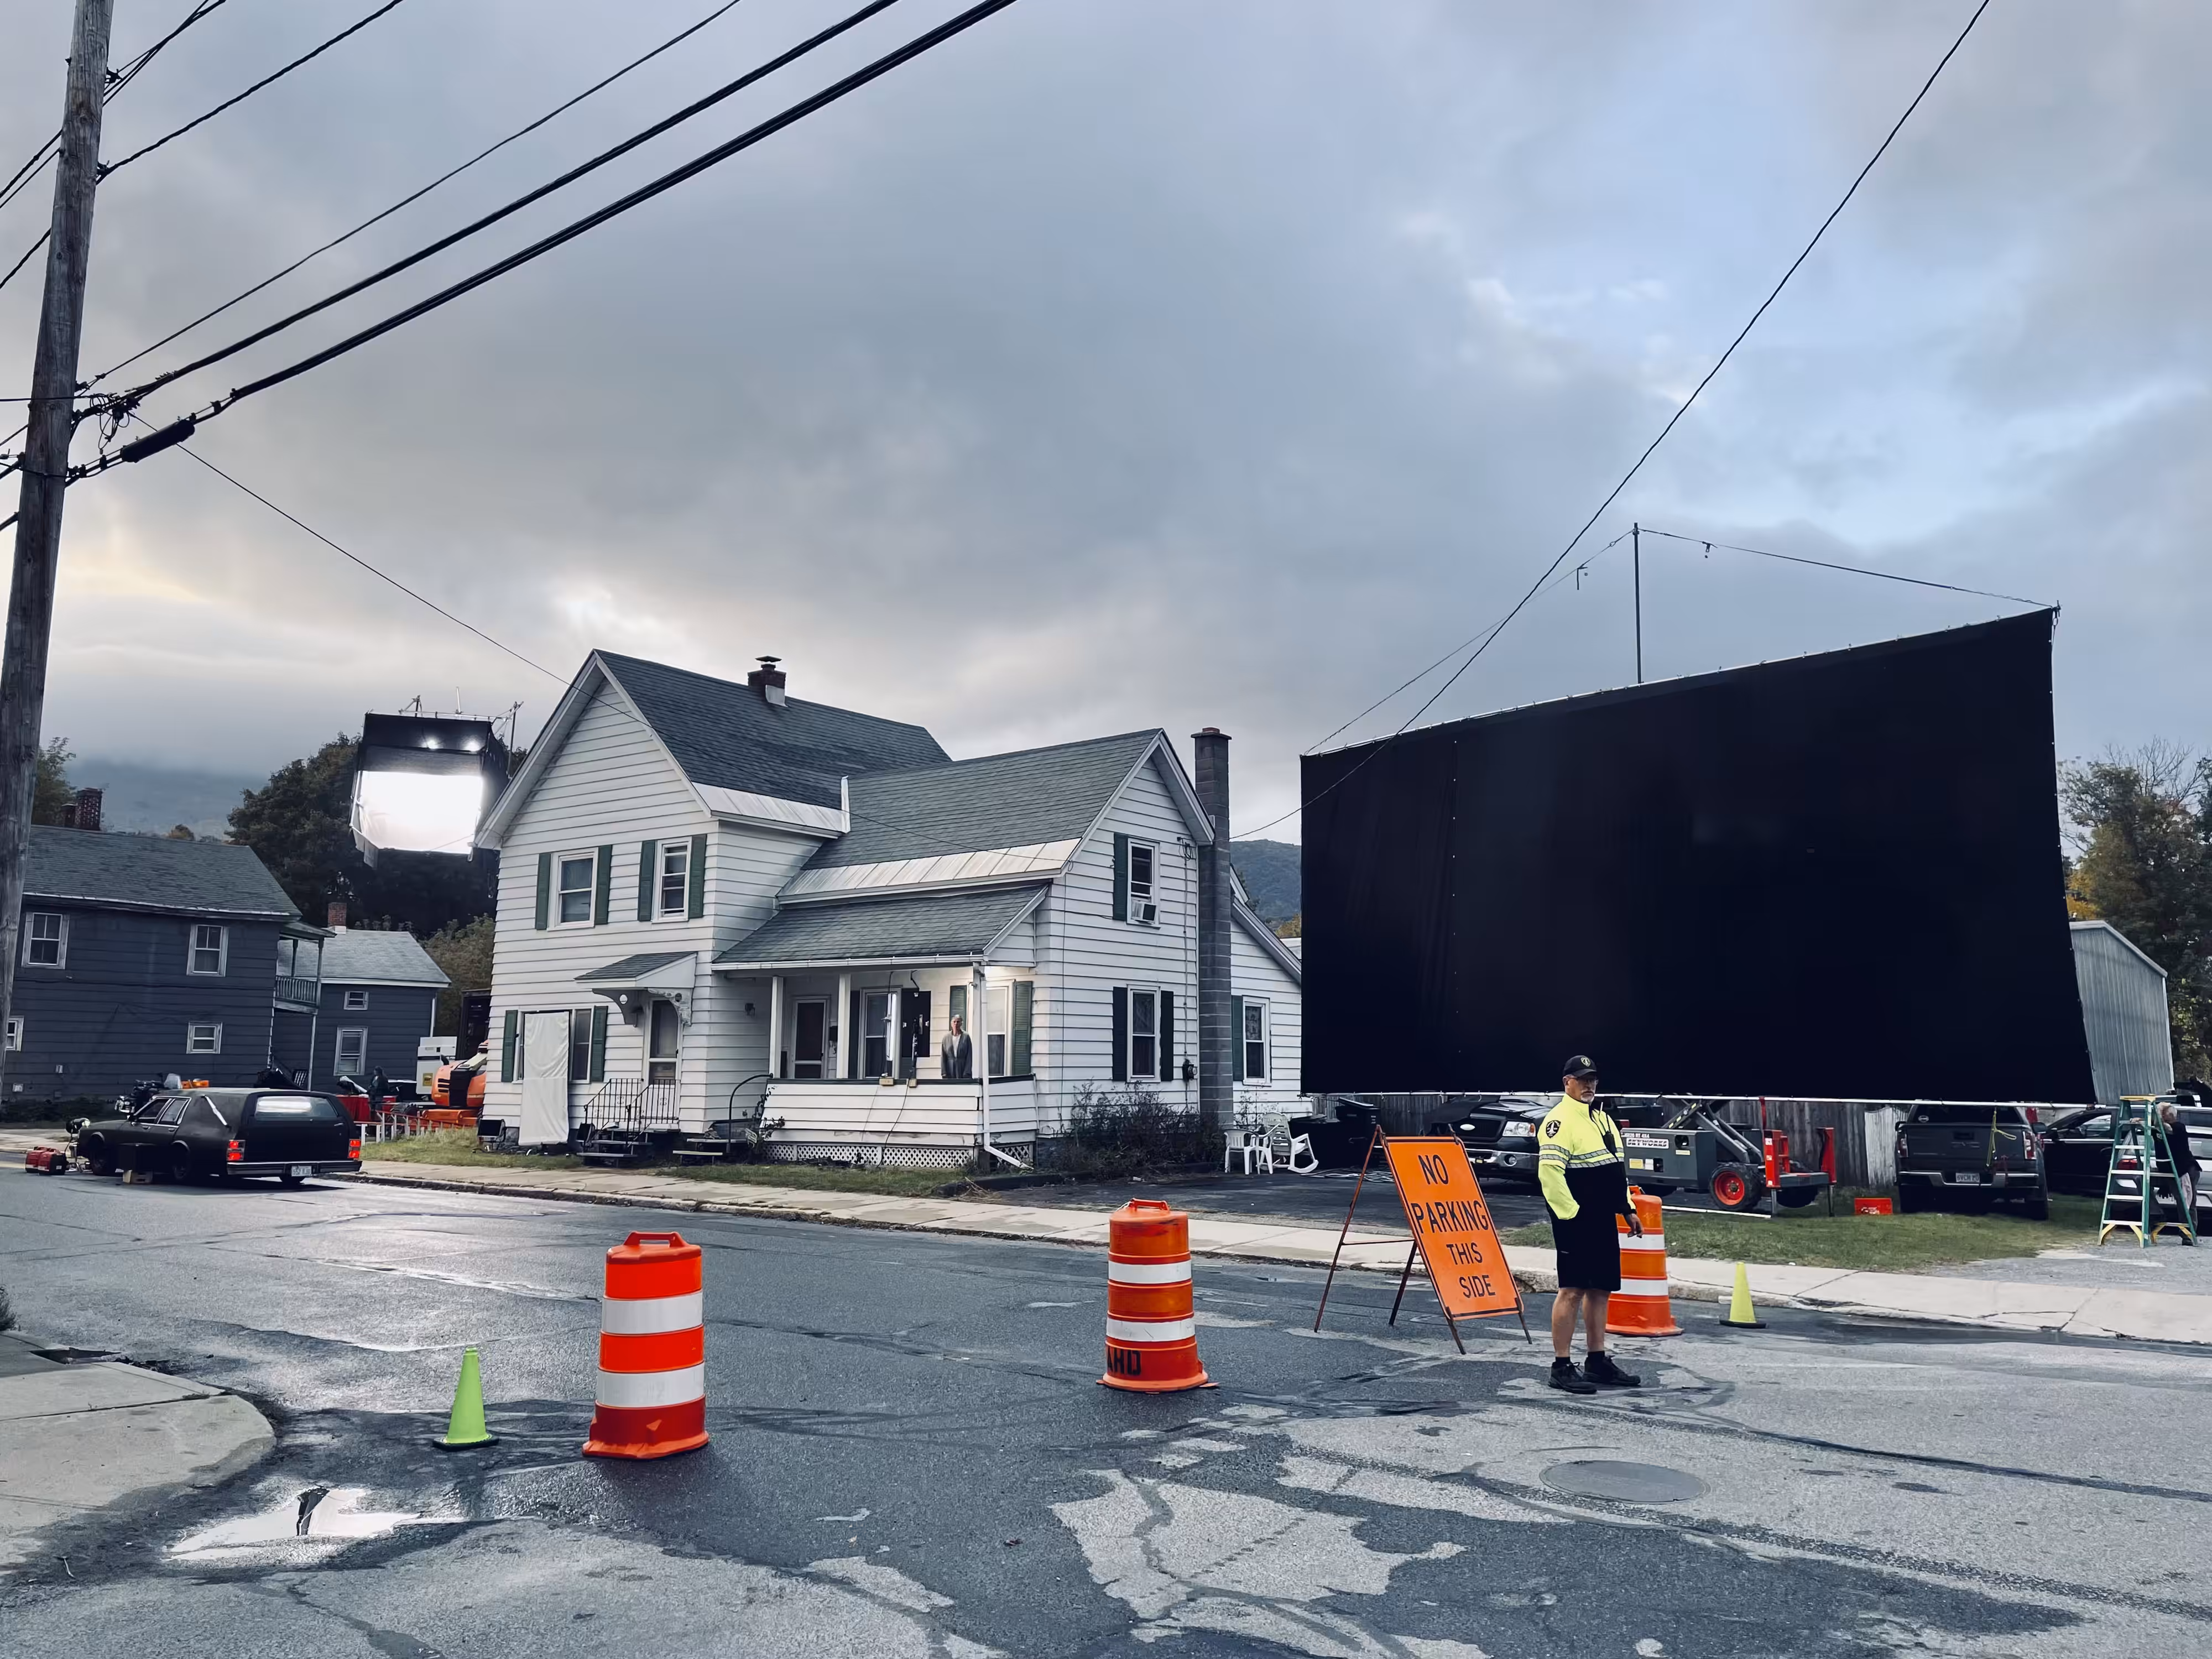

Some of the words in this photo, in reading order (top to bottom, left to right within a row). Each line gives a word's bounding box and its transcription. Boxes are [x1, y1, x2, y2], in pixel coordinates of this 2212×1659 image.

[1418, 1154, 1449, 1185] NO
[1411, 1200, 1489, 1234] PARKING
[1446, 1242, 1483, 1265] THIS
[1459, 1275, 1496, 1298] SIDE
